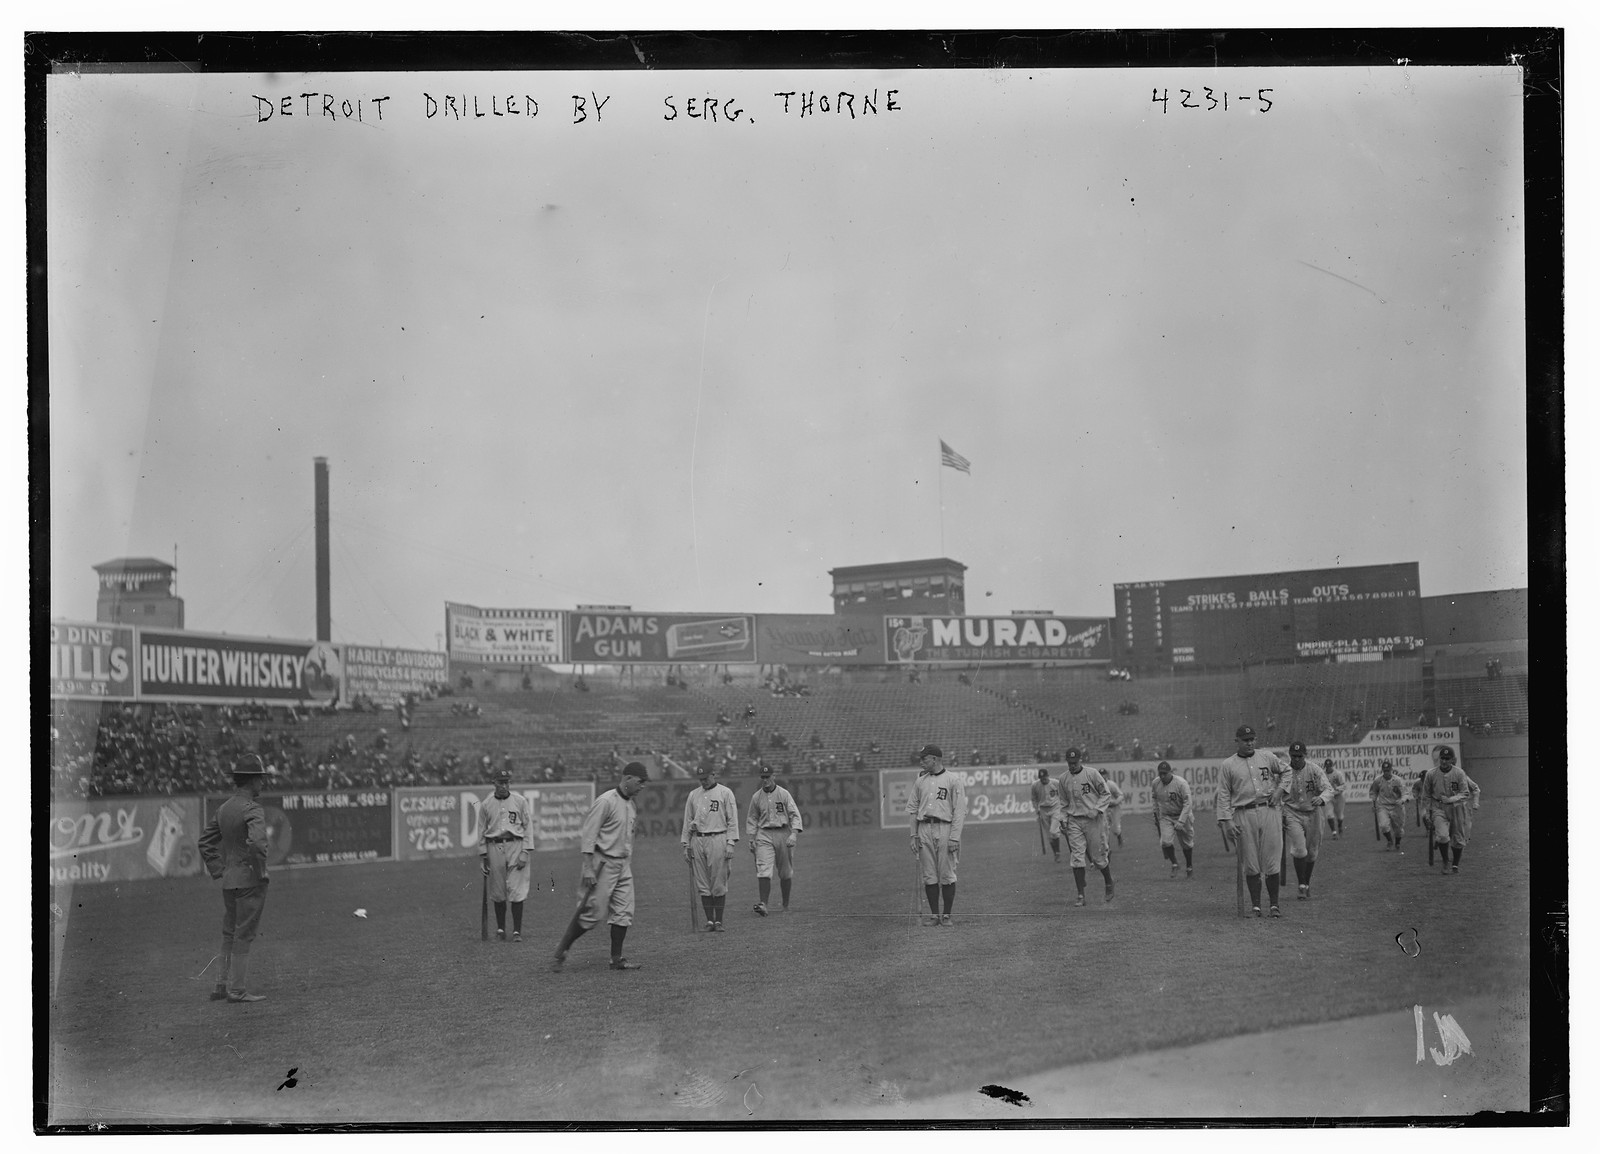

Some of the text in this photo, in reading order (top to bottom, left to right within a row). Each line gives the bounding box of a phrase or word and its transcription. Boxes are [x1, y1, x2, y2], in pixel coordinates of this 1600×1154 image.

[1187, 583, 1350, 606] STRIKES BALLS OUTS
[68, 627, 113, 646] DINE
[454, 623, 554, 642] BLACK & WHITE
[575, 615, 659, 644] ADAMS
[932, 618, 1068, 647] MURAD
[594, 639, 642, 657] GUM
[925, 647, 1092, 659] THE TURKISH CIGARETTE
[1362, 644, 1394, 653] MONDAY
[142, 644, 305, 690] HUNTER WHISKEY
[1370, 729, 1454, 743] ESTABLISHED 1901
[1352, 747, 1394, 757] DETECTIVE
[1395, 744, 1429, 755] BUREAU
[1183, 766, 1221, 786] CIGAR
[282, 795, 300, 810] HIT
[302, 794, 325, 809] THIS
[325, 793, 350, 809] SIGN
[818, 808, 874, 828] MILES
